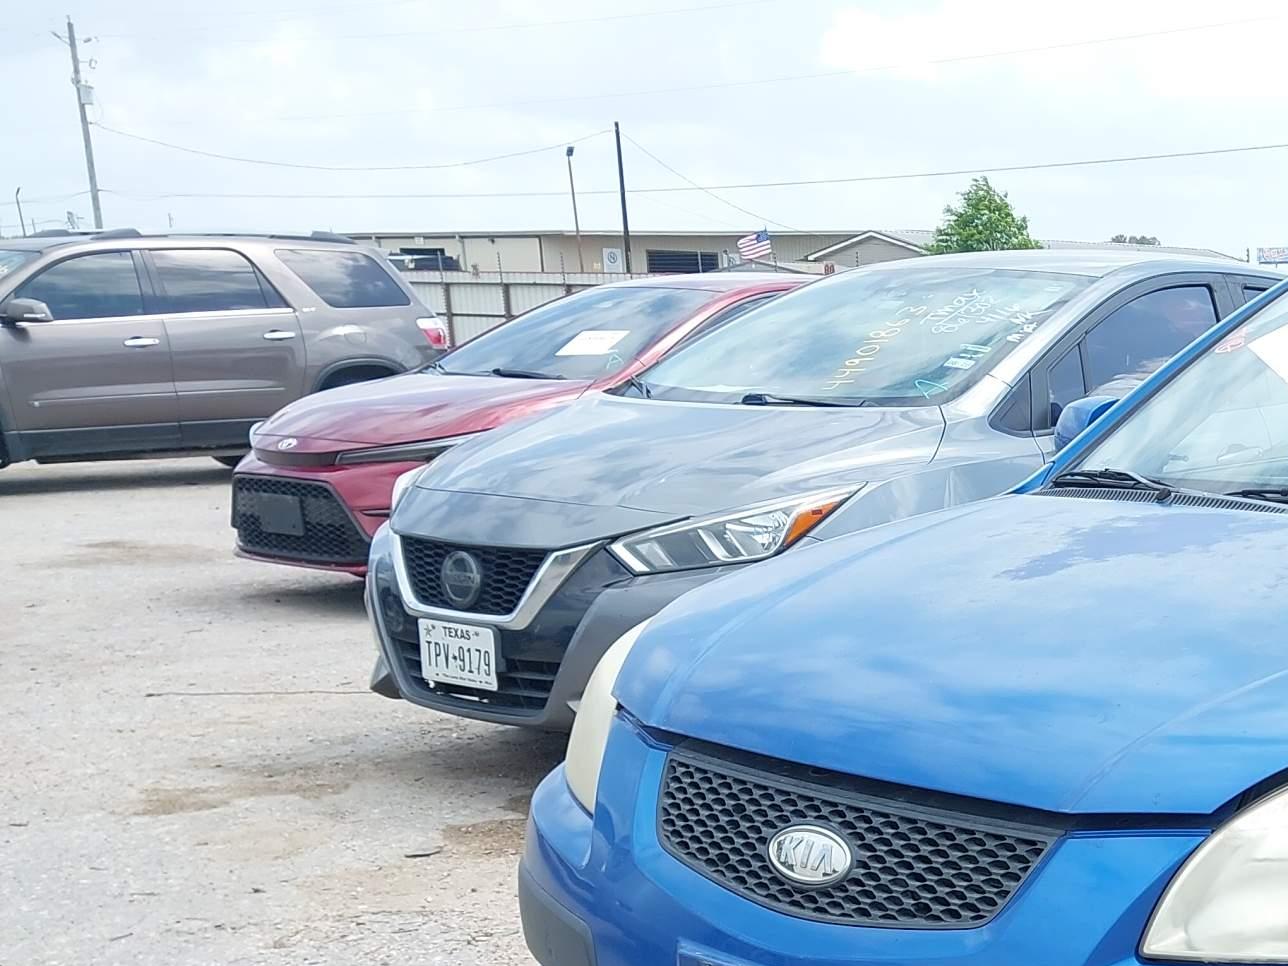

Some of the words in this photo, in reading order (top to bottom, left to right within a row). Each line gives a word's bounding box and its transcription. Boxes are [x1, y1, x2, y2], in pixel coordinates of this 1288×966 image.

[822, 305, 928, 390] 44901863
[442, 626, 471, 640] TEXAS
[776, 835, 834, 876] KIA
